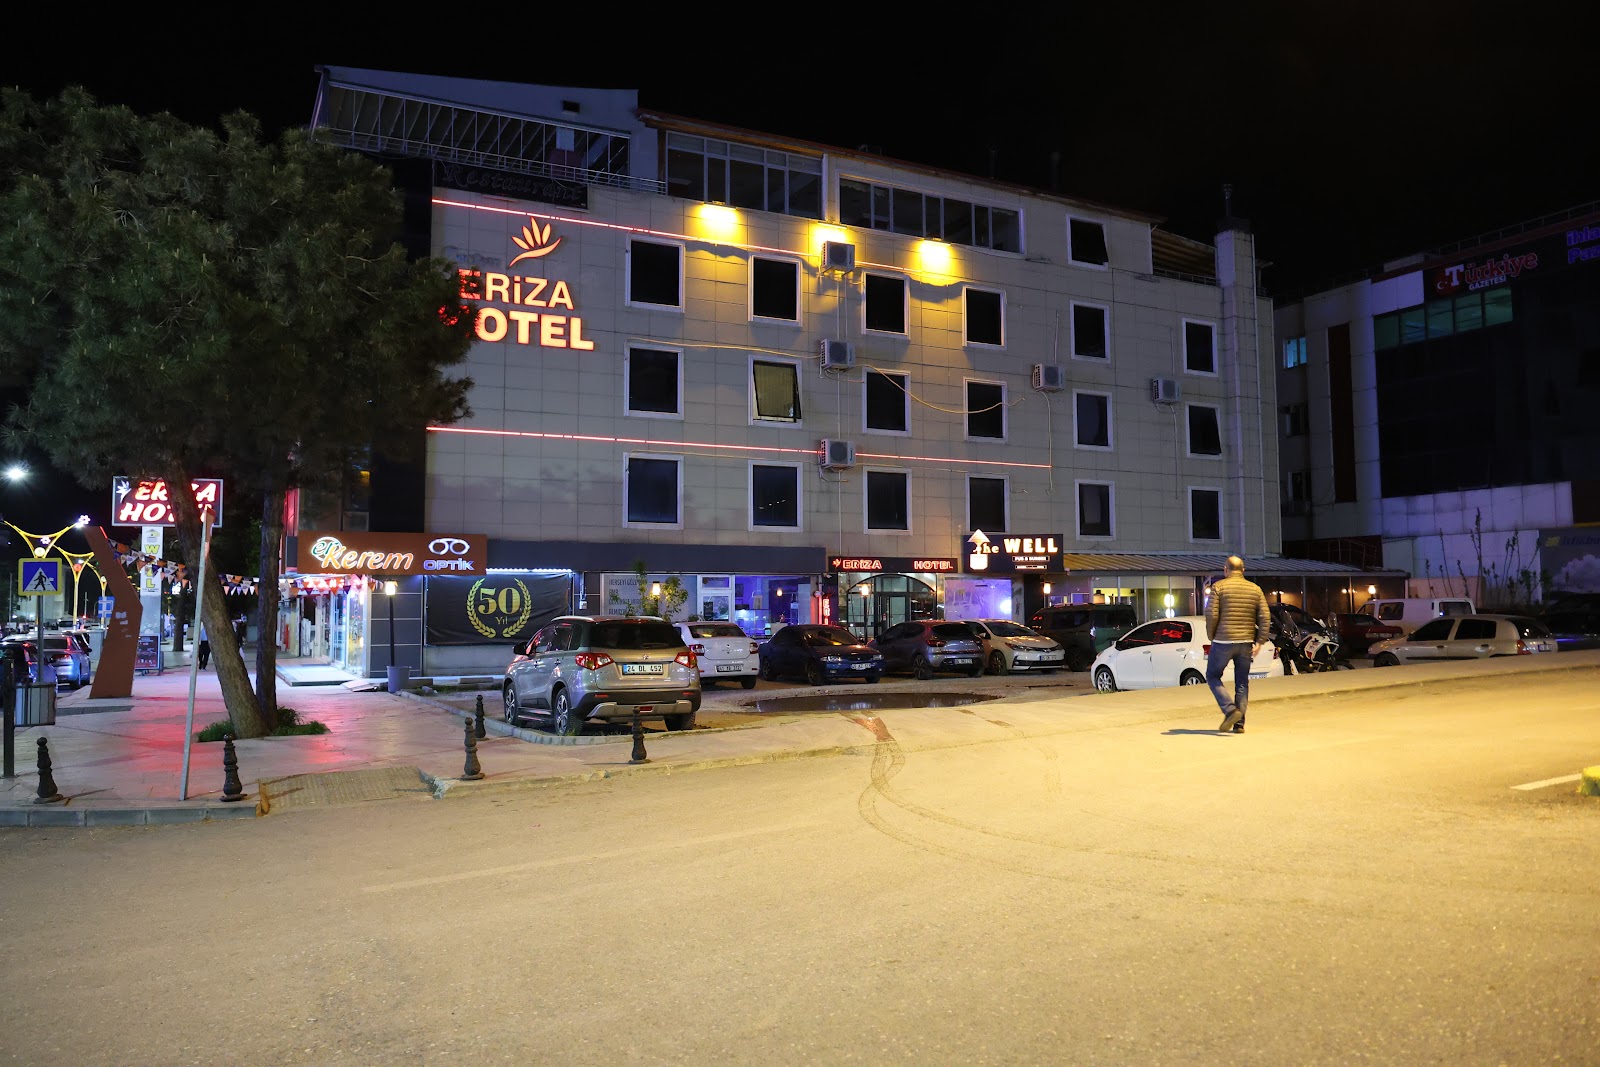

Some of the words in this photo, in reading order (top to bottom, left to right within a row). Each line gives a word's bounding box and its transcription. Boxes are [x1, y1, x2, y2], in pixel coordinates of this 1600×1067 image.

[1445, 253, 1538, 287] Türkiye
[438, 305, 595, 351] OTEL
[322, 544, 414, 570] Kerem
[1003, 537, 1059, 554] WELL
[914, 560, 953, 569] HOTEL
[478, 587, 521, 615] 50
